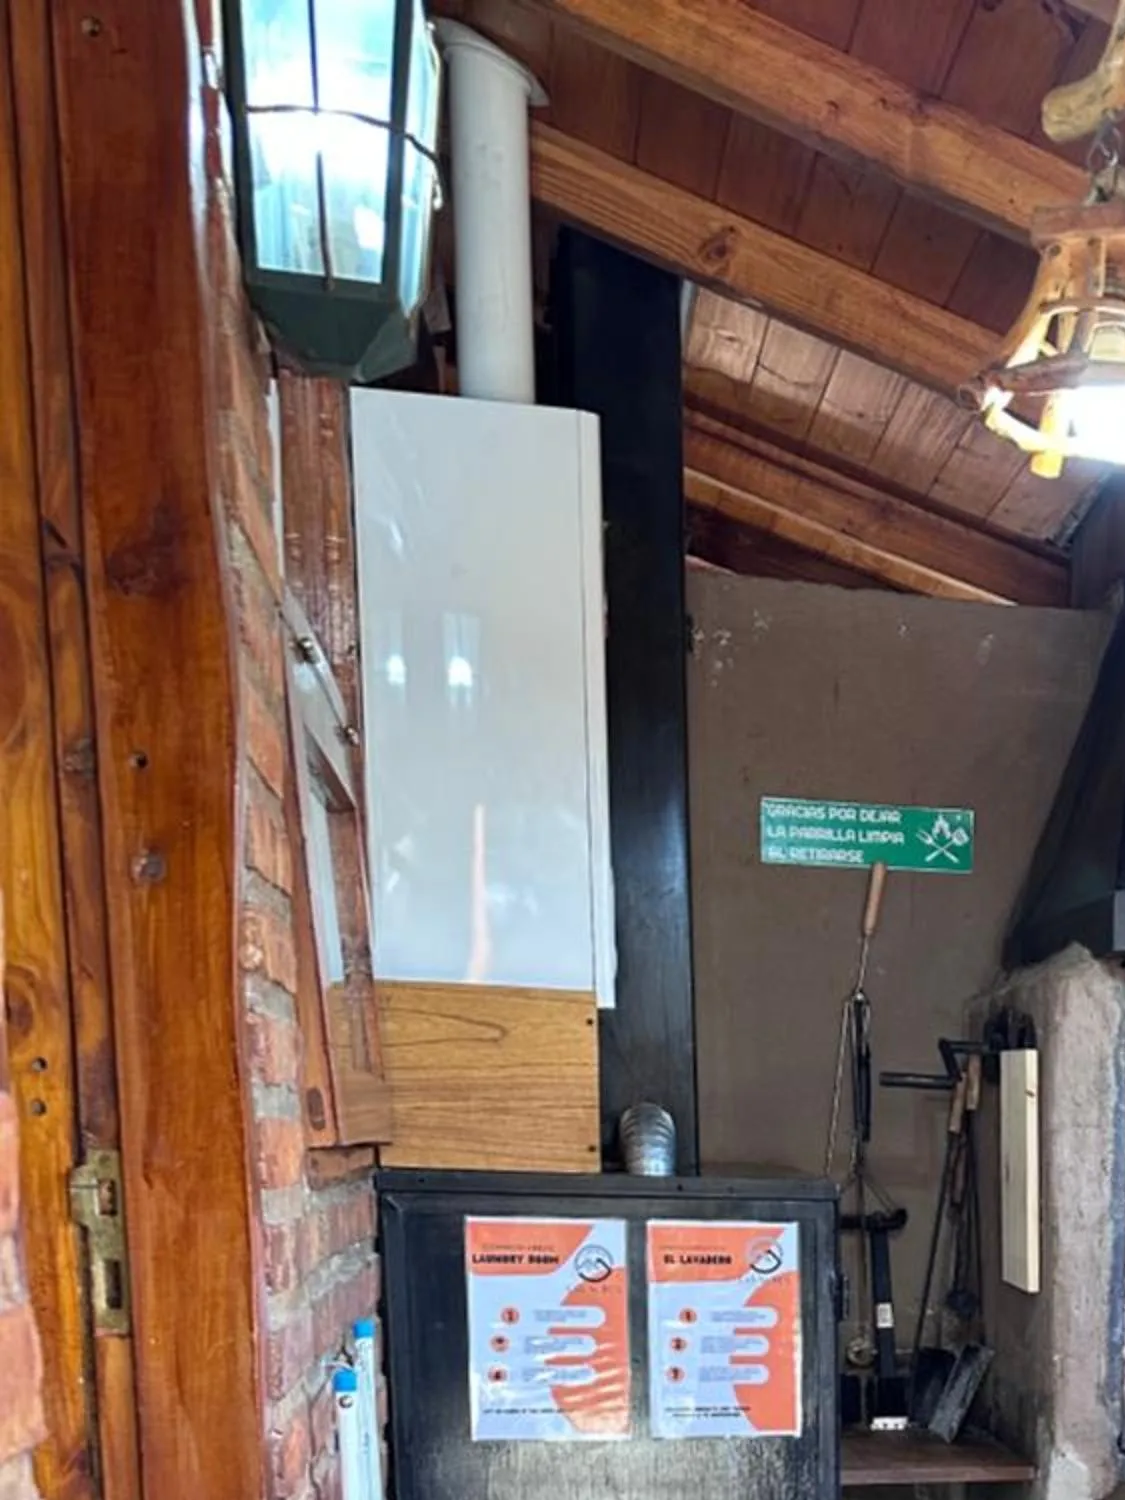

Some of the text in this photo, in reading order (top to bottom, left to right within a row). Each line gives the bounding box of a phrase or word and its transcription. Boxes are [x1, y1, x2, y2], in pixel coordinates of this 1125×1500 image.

[829, 808, 857, 820] POR
[859, 809, 901, 822] DEJAR
[766, 826, 905, 843] LA PARRILLA LIMPIA
[472, 1253, 523, 1264] LAUNDRY
[664, 1254, 675, 1264] EL
